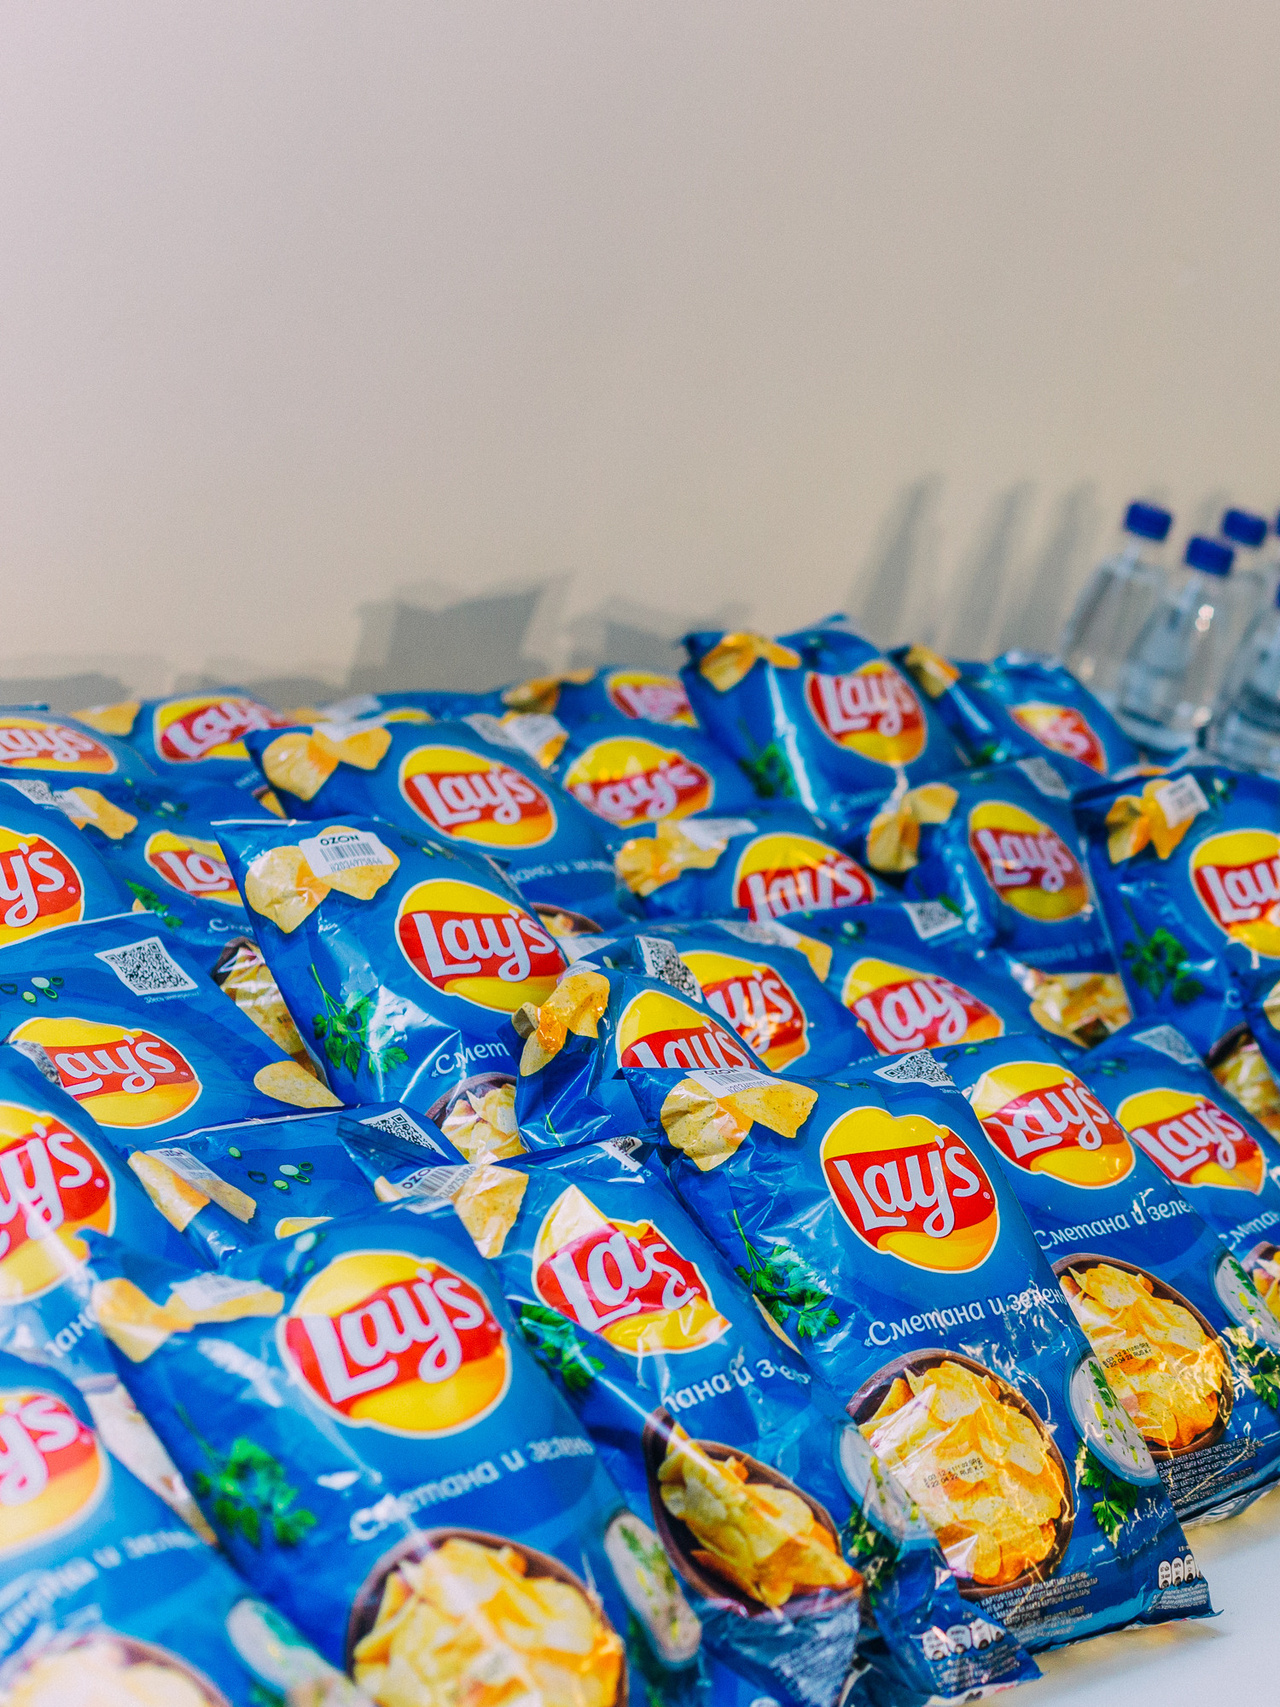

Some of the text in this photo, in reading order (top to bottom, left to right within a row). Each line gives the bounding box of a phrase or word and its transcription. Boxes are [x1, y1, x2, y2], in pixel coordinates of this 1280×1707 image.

[413, 767, 537, 825] Lay's
[321, 835, 360, 846] OZON
[977, 823, 1074, 893] Lay's
[0, 842, 66, 928] y's
[410, 907, 557, 983] Lay's
[983, 1077, 1109, 1160] Lay's
[1132, 1099, 1244, 1178] Lay's
[402, 1168, 431, 1190] OZO
[832, 1135, 981, 1239] Lay's
[1034, 1212, 1131, 1250] Сметана
[302, 1266, 486, 1404] Lay's
[987, 1297, 1007, 1316] и
